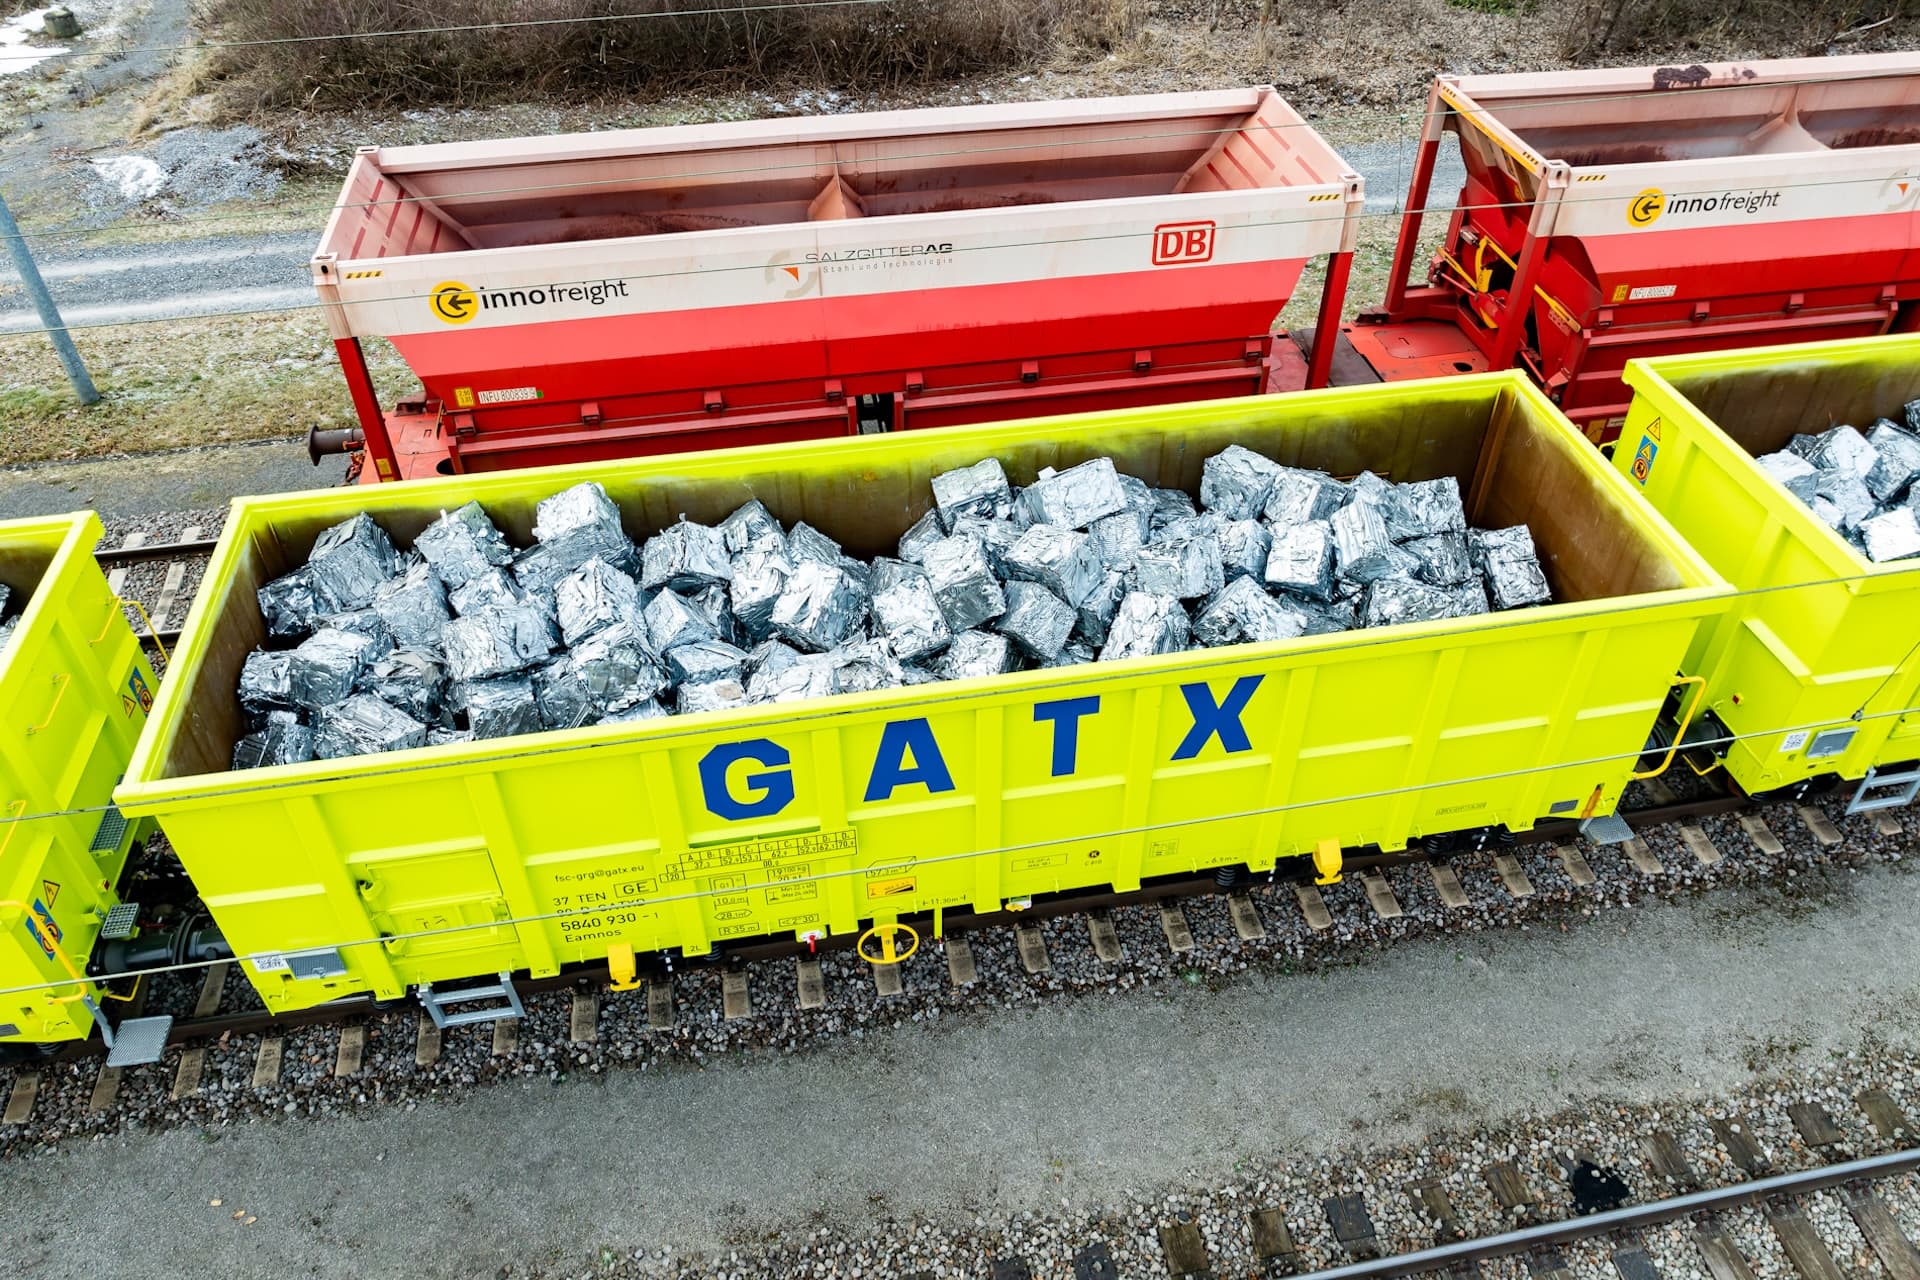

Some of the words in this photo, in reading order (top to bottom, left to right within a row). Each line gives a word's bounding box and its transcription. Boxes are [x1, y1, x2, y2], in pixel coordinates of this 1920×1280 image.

[1667, 189, 1781, 214] innofreight
[1160, 228, 1207, 259] DB
[823, 264, 855, 274] Stahl
[858, 261, 878, 271] und
[883, 257, 953, 269] Technologie
[480, 279, 629, 309] innofreight
[480, 391, 500, 402] INFU
[697, 674, 1265, 821] GATX
[622, 881, 650, 895] GE
[553, 897, 569, 907] 37
[576, 892, 607, 903] TEN
[561, 917, 601, 931] 5840
[606, 912, 637, 926] 930
[565, 929, 622, 943] Eamnos
